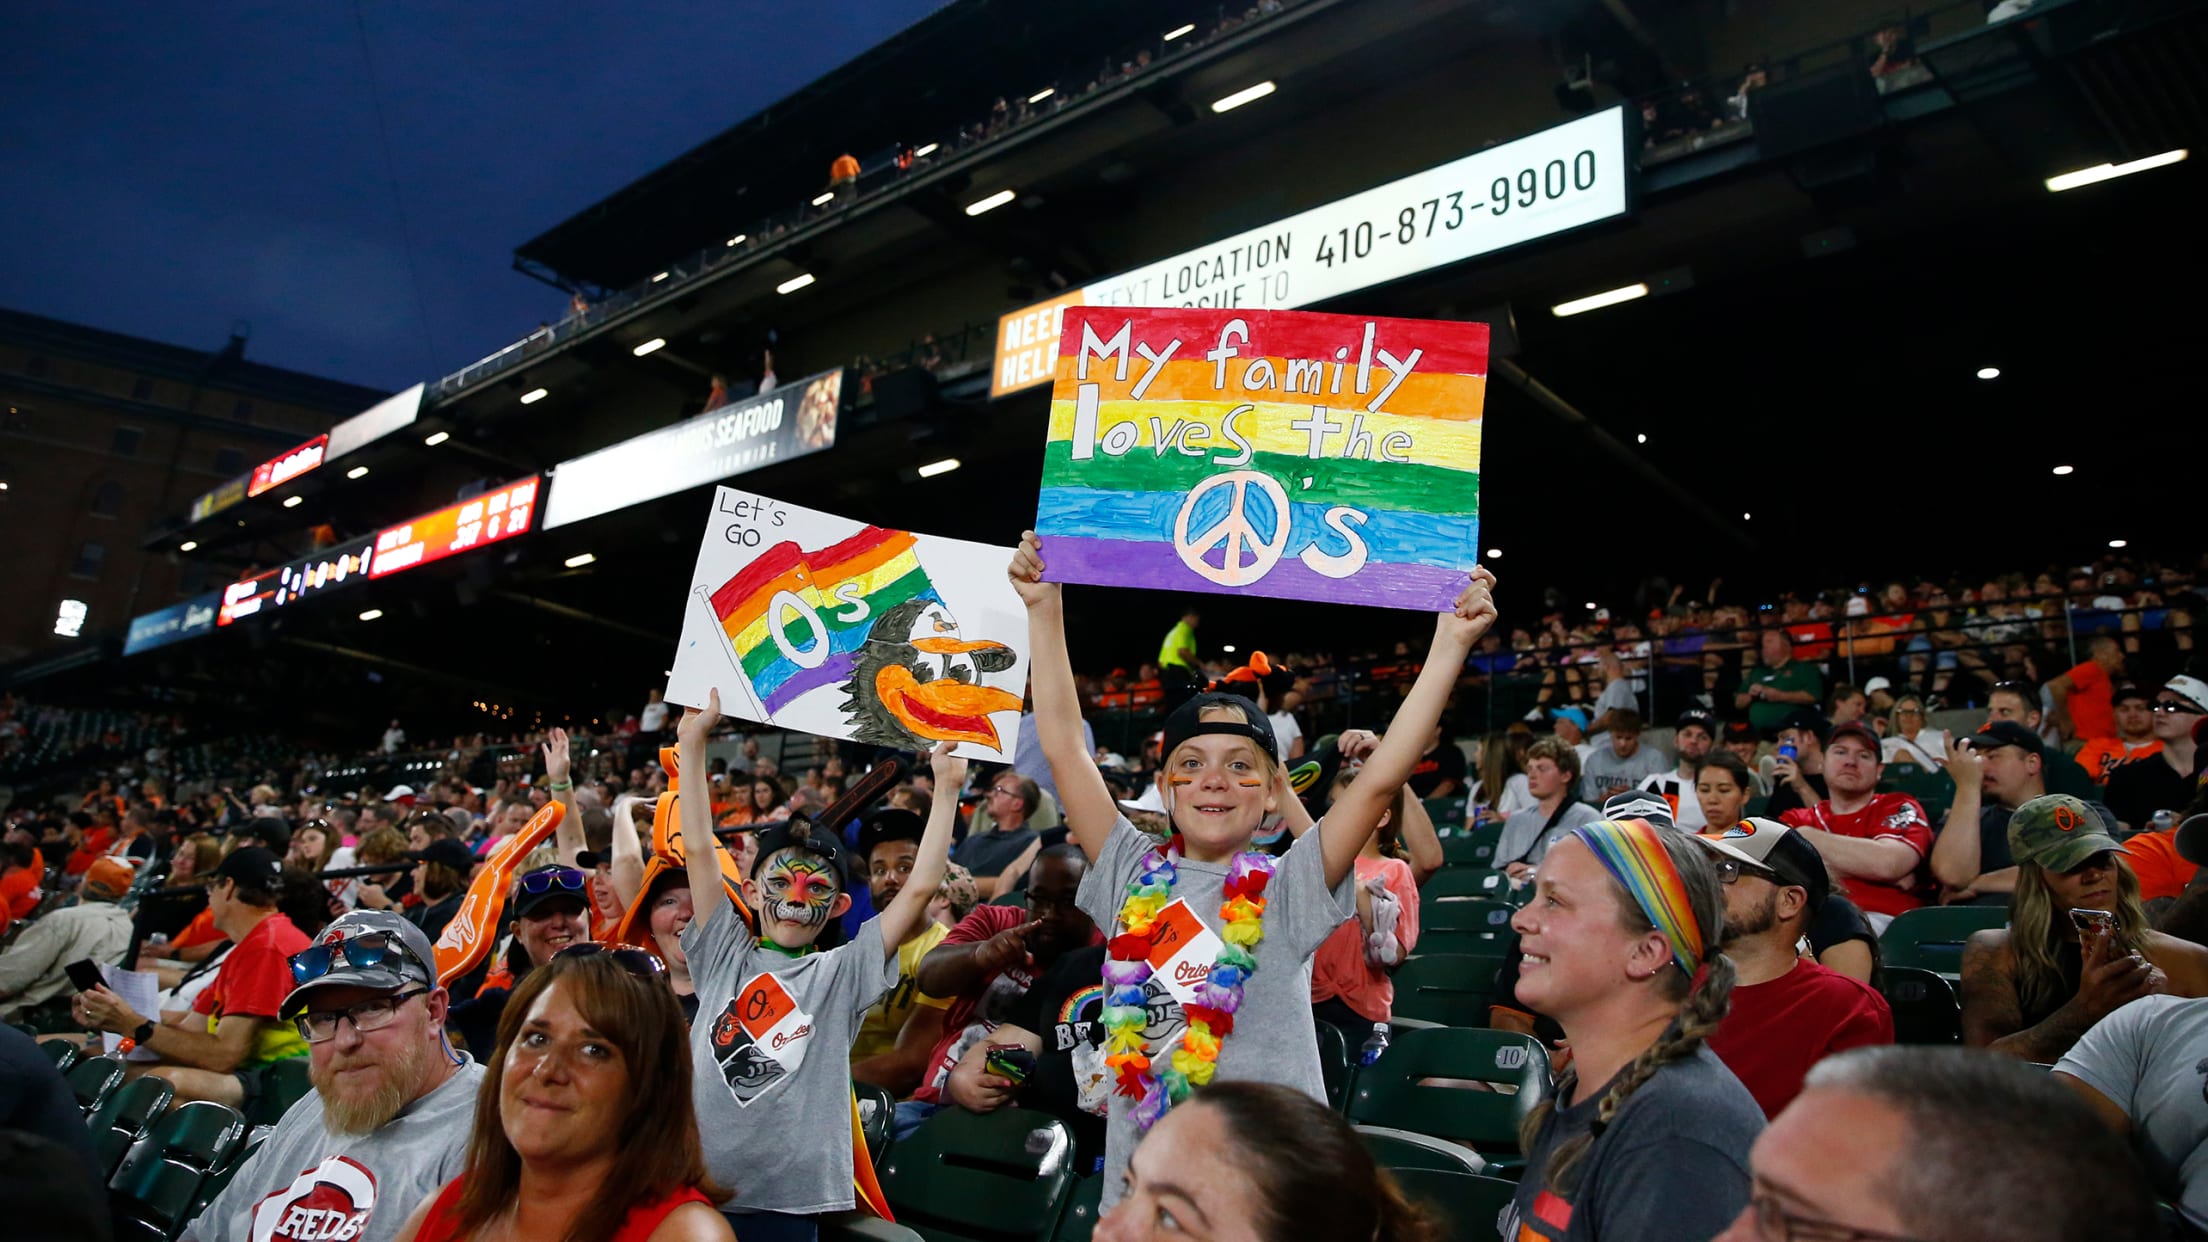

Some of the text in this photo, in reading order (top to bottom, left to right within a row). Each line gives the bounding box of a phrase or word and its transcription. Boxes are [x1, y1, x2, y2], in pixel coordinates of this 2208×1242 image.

[1315, 149, 1597, 268] 410-873-9900
[1163, 232, 1292, 300] LOCATION
[1260, 270, 1289, 305] TO
[1078, 318, 1423, 413] My family
[714, 398, 784, 448] SEAFOOD
[1292, 405, 1414, 463] the
[719, 492, 786, 527] Let's
[725, 524, 761, 547] GO
[1501, 1049, 1520, 1065] 10
